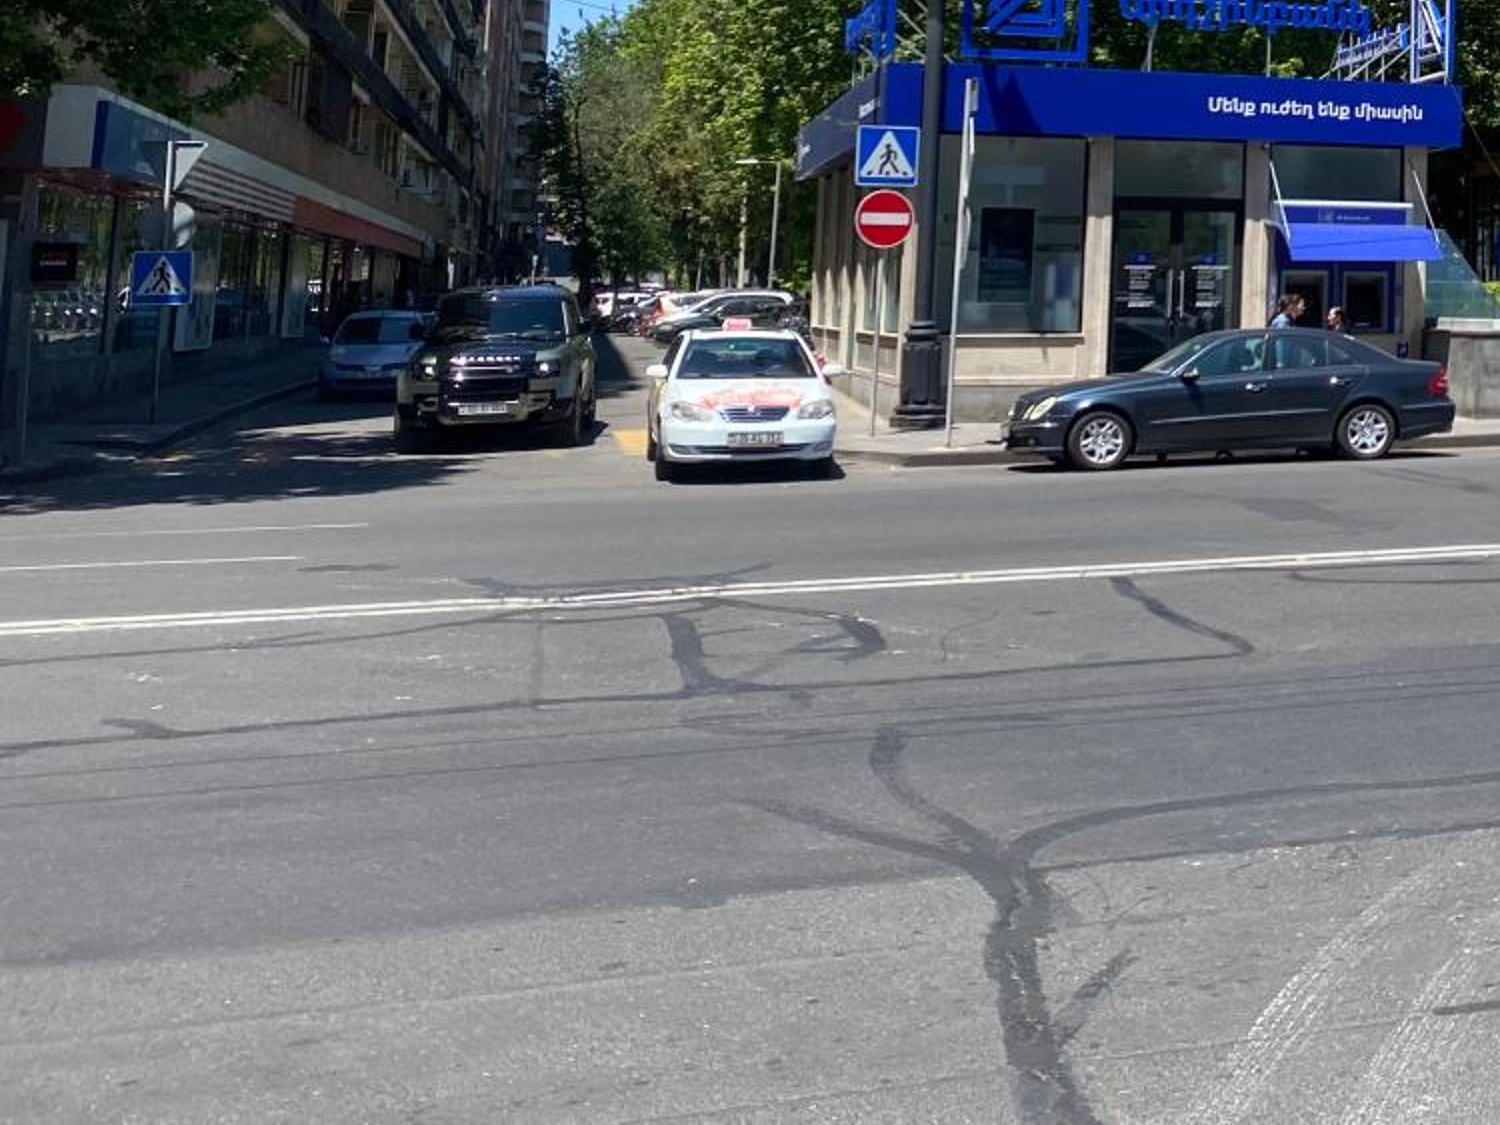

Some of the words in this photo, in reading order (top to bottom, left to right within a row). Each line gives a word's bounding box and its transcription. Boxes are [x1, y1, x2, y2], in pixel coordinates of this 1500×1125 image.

[1208, 96, 1256, 116] Մենք
[1260, 99, 1314, 120] ուժեղ
[1318, 101, 1350, 120] ենք
[1354, 102, 1423, 122] միասին
